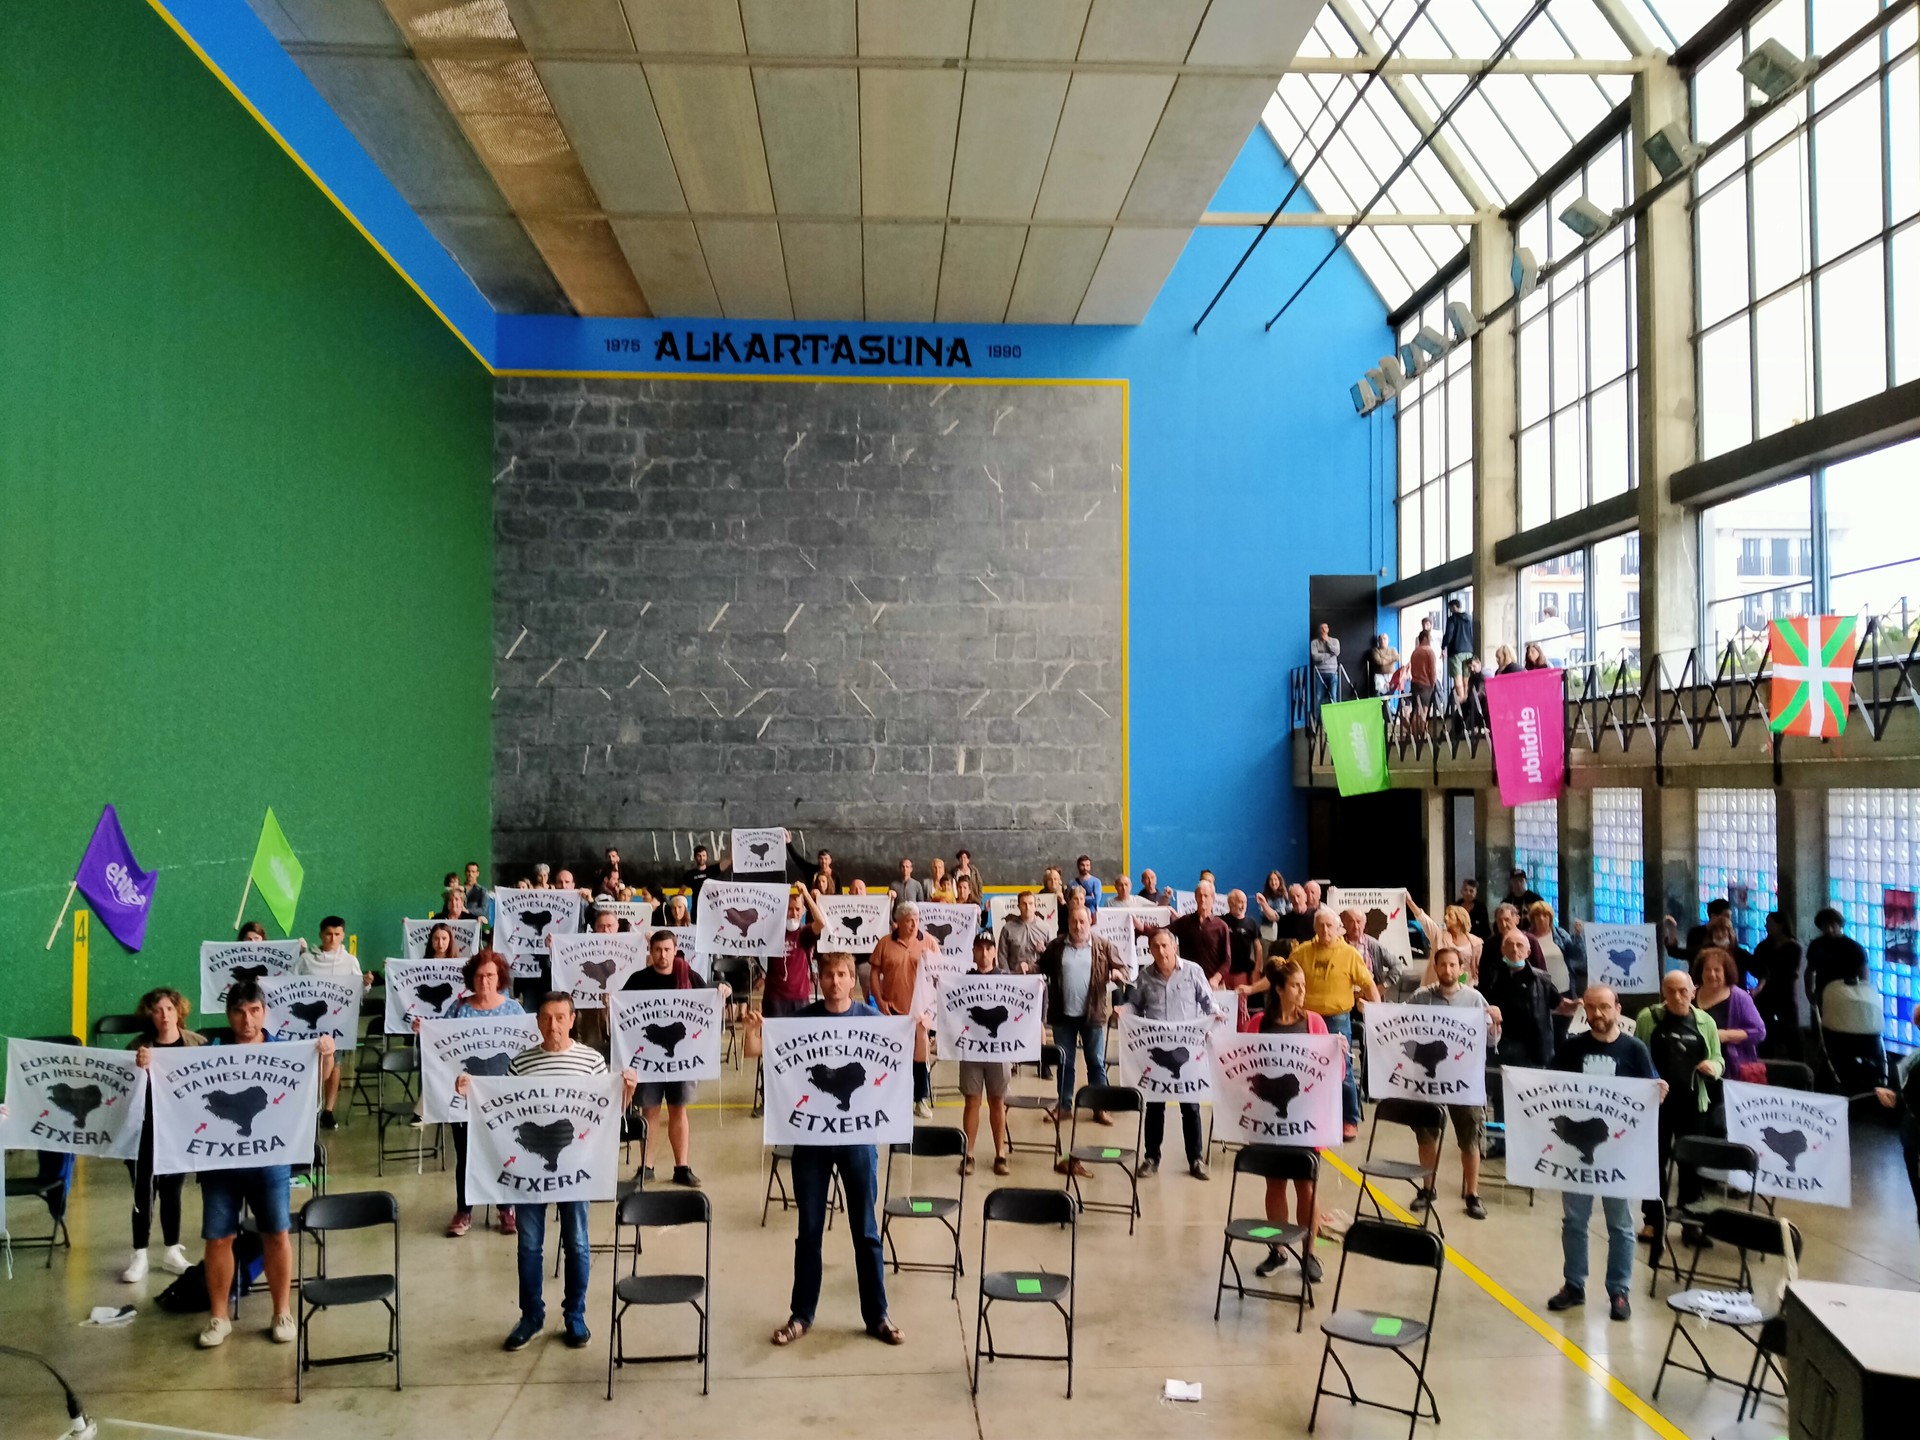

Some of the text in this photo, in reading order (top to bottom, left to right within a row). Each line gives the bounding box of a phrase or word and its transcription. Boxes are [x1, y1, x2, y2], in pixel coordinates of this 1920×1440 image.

[654, 331, 972, 367] ALKARTASUNA
[502, 893, 573, 908] EUSKAL PRESO
[706, 887, 781, 904] EUSKAL PRESO
[709, 896, 777, 914] ETA IHESLARIAK
[520, 901, 572, 918] IHESLARIAK
[76, 916, 86, 947] 4
[508, 935, 543, 948] ETXE
[713, 934, 767, 949] ETXERA
[828, 934, 880, 946] ETXERA
[209, 946, 293, 963] EUSKAL PRESO
[560, 939, 638, 956] EUSKAL PRESO
[582, 950, 635, 963] IHESLARIAK
[209, 955, 292, 974] ETA IHESLARIAK
[394, 965, 463, 980] EUSKAL PRE
[266, 990, 352, 1010] ETA IHESLARIAK
[267, 980, 354, 999] EUSKAL PRESO
[946, 983, 1034, 1000] EUSKAL PRESO
[619, 998, 713, 1019] EUSKAL PRESO
[946, 993, 1033, 1014] ETA IHESLARIAK
[619, 1010, 712, 1031] ETA IHESLARIAK
[1128, 1025, 1206, 1038] EUSKAL PRES
[1375, 1014, 1477, 1037] EUSKAL PRESO
[434, 1026, 539, 1049] EUSKAL PRESO
[775, 1030, 902, 1056] EUSKAL PRESO
[955, 1037, 1026, 1053] ETXERA
[1128, 1035, 1206, 1052] ETA IHESLARIA
[1376, 1026, 1476, 1052] ETA IHESLARIAK
[440, 1040, 528, 1062] ETA IHESLARIA
[774, 1045, 902, 1075] ETA IHESLARIAK
[1219, 1043, 1330, 1066] EUSKAL PRESO
[20, 1056, 136, 1082] EUSKAL PRESO
[166, 1054, 306, 1083] EUSKAL PRESO
[629, 1055, 705, 1073] ETXERA
[1225, 1057, 1326, 1082] ETA IHESLARIAK
[25, 1068, 130, 1097] ETA IHESLARIAK
[173, 1071, 300, 1100] ETA IHESLARIAK
[1138, 1075, 1210, 1094] ETXERA
[1388, 1072, 1470, 1096] ETXERA
[481, 1089, 549, 1113] EUSKAL
[555, 1088, 609, 1108] PRESO
[1517, 1083, 1646, 1112] EUSKAL PRESO
[486, 1104, 604, 1130] ETA IHESLARIAK
[788, 1109, 890, 1133] ETXERA
[1523, 1099, 1640, 1129] ETA IHESLARIAK
[1735, 1097, 1837, 1126] EUSKAL PRESO
[30, 1121, 112, 1145] ETXERA
[1239, 1115, 1317, 1137] ETXERA
[1740, 1111, 1833, 1141] ETA IHESLARIAK
[186, 1135, 286, 1157] ETXERA
[497, 1169, 591, 1192] ETXERA
[1534, 1157, 1627, 1184] ETXERA
[1760, 1168, 1823, 1191] TXERA
